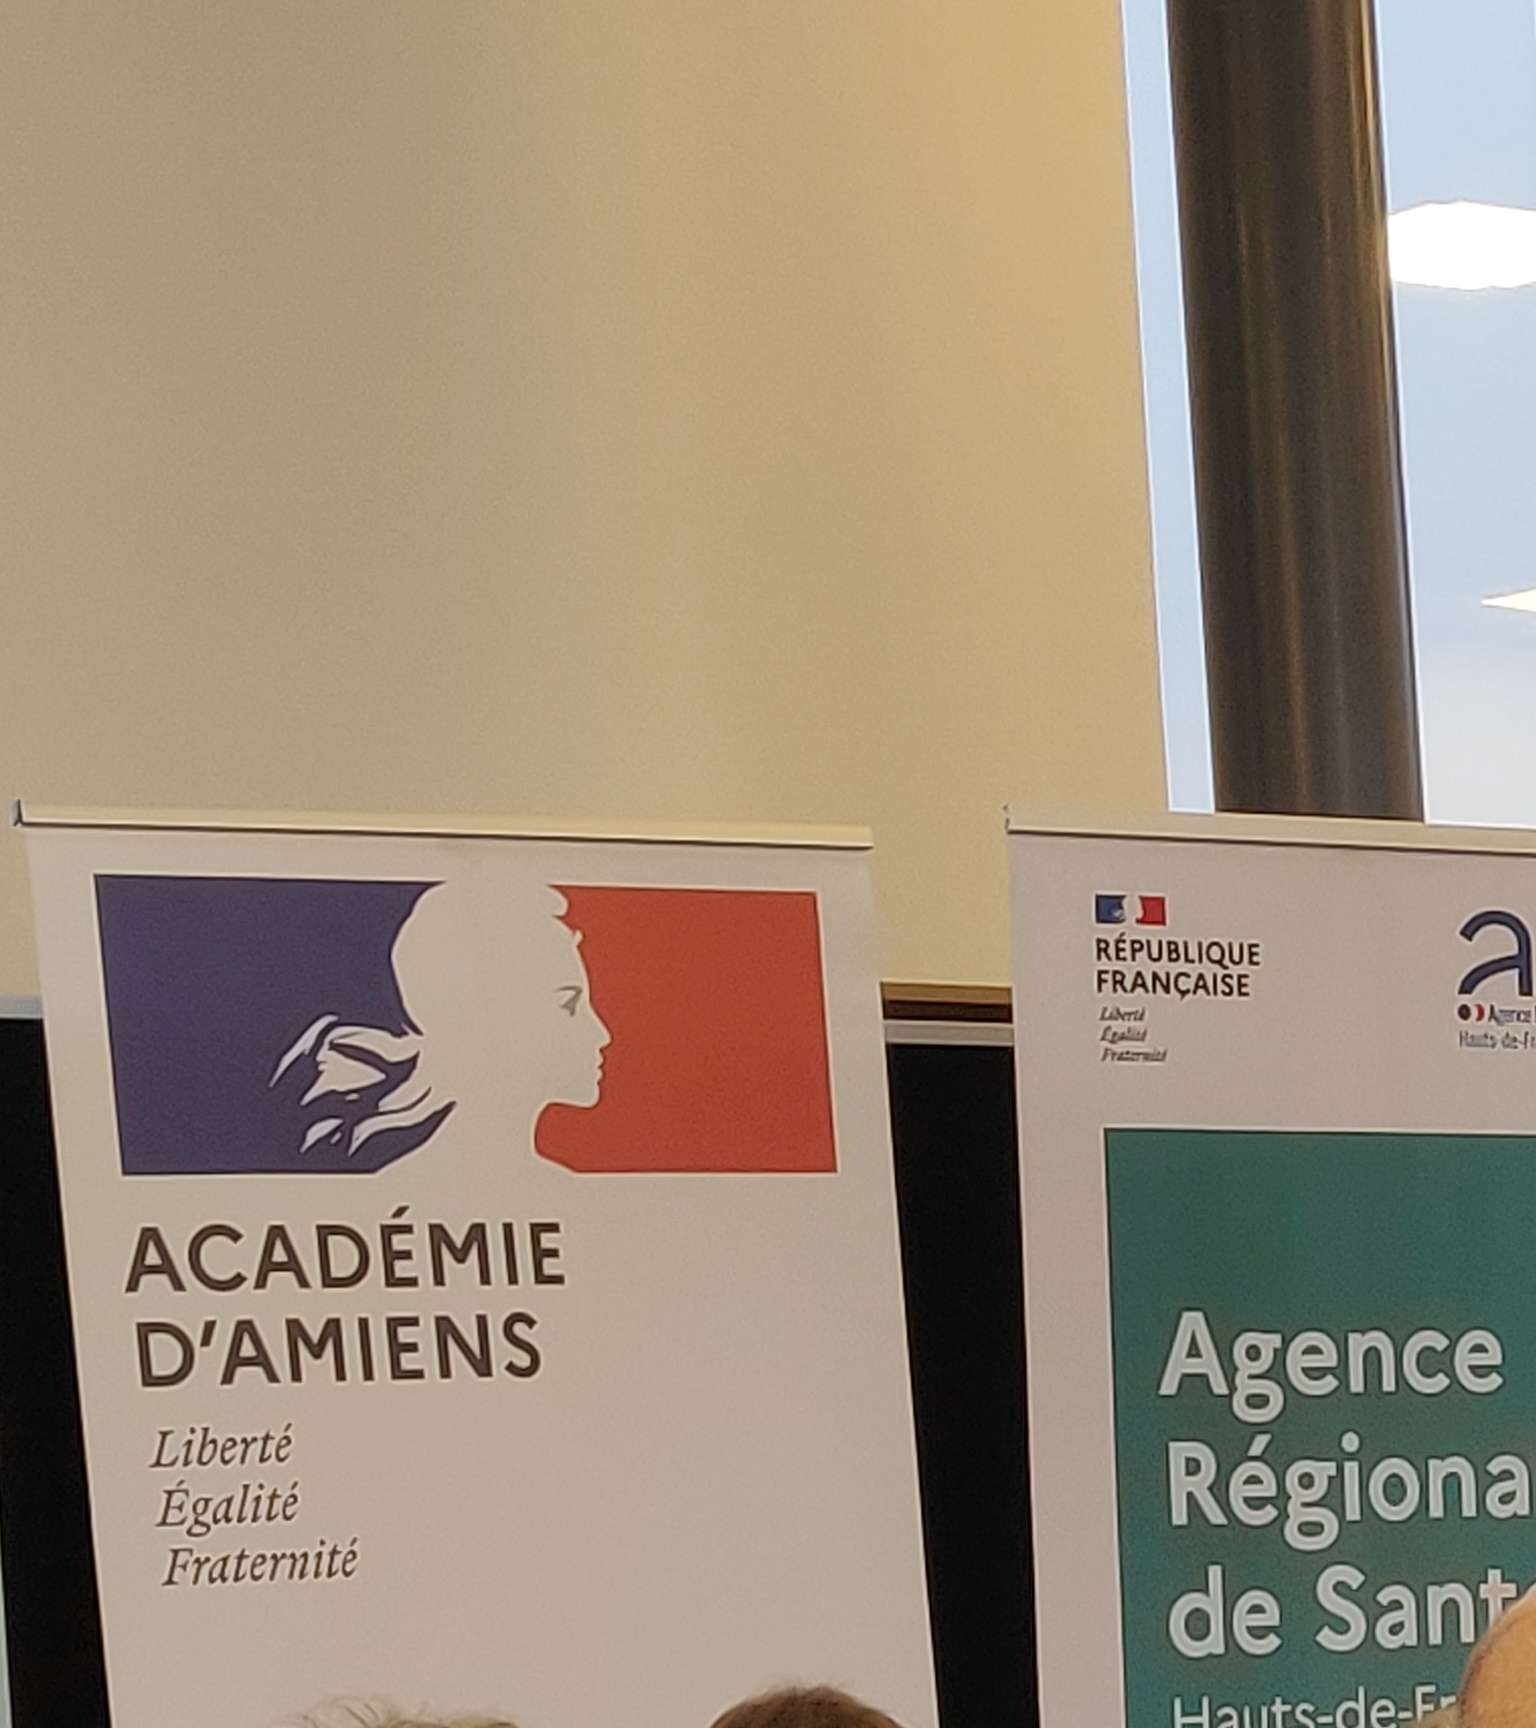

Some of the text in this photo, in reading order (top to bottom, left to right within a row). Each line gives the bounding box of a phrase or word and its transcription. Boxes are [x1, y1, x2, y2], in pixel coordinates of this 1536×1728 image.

[1096, 932, 1261, 968] RÉPUBLIQUE
[1097, 969, 1251, 1001] FRANÇAISE
[125, 1205, 566, 1294] ACADÉMIE
[136, 1312, 541, 1388] D'AMIENS
[1158, 1311, 1504, 1423] Agence
[149, 1423, 293, 1469] Liberté
[156, 1481, 299, 1537] Égalité
[162, 1538, 358, 1587] Fraternité
[1168, 1565, 1282, 1658] de
